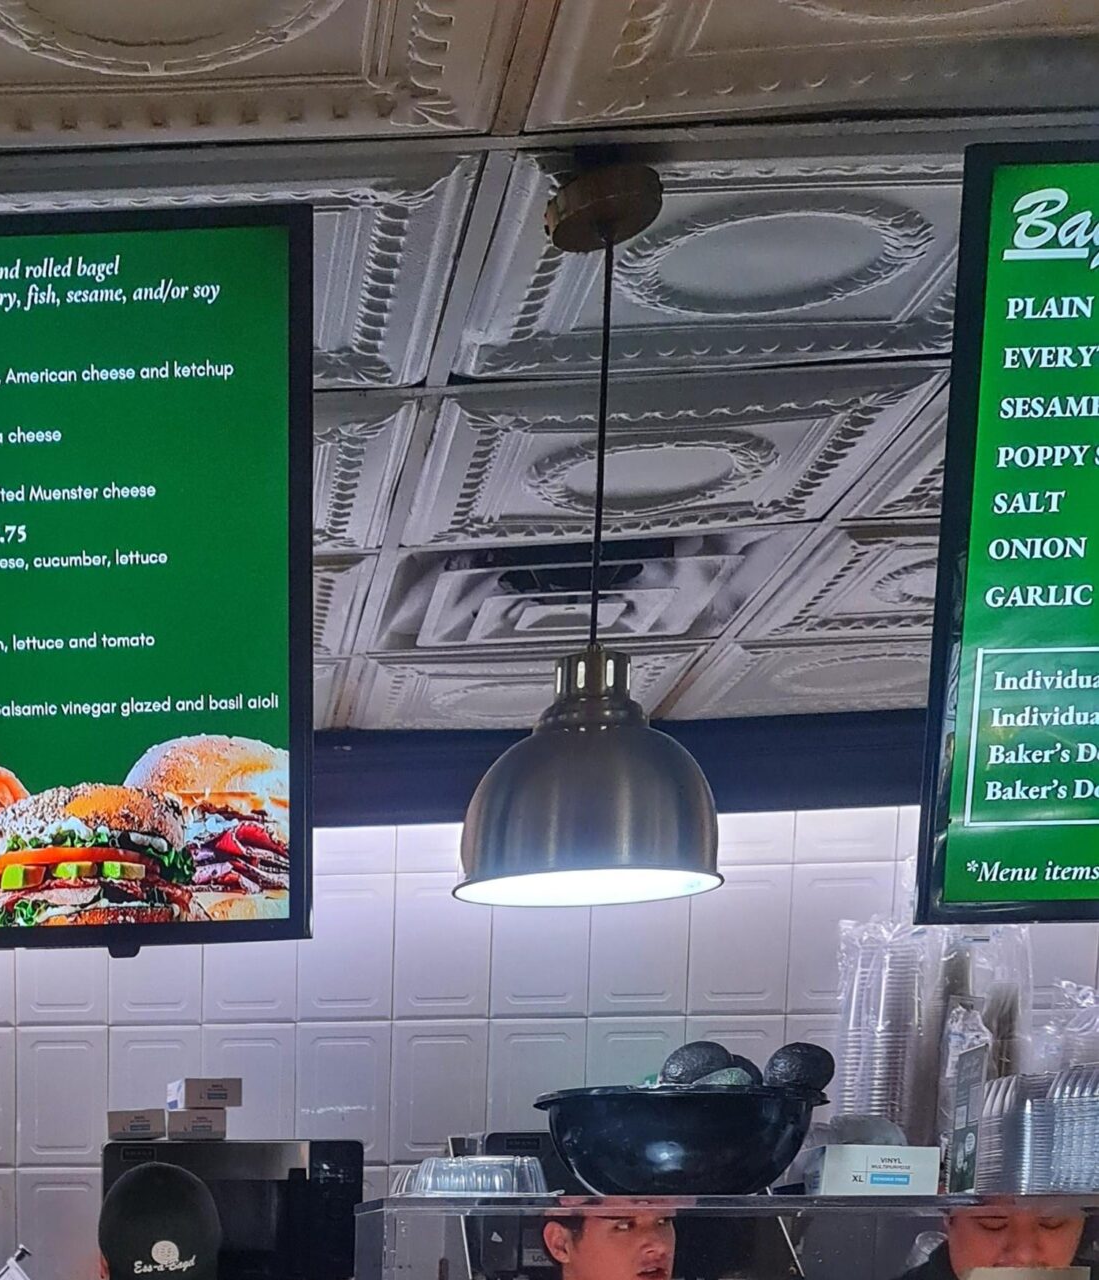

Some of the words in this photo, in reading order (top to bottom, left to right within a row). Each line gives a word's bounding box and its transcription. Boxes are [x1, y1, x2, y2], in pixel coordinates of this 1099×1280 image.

[25, 256, 73, 279] rolled
[76, 254, 120, 283] bagel
[23, 283, 61, 312] fish,
[65, 288, 127, 305] sesame,
[132, 278, 189, 304] and/or
[192, 284, 221, 305] soy
[1005, 296, 1095, 320] PLAIN
[1003, 345, 1099, 369] EVERY
[7, 426, 62, 444] cheese
[996, 444, 1091, 468] POPPY
[993, 490, 1066, 515] SALT
[988, 536, 1088, 560] ONION
[985, 584, 1093, 608] GARLIC
[61, 701, 117, 718] vinegar
[120, 695, 171, 717] glazed
[175, 694, 205, 712] and
[208, 693, 243, 711] basil
[247, 692, 279, 709] aioli
[1044, 860, 1099, 881] items
[852, 1174, 864, 1183] XL
